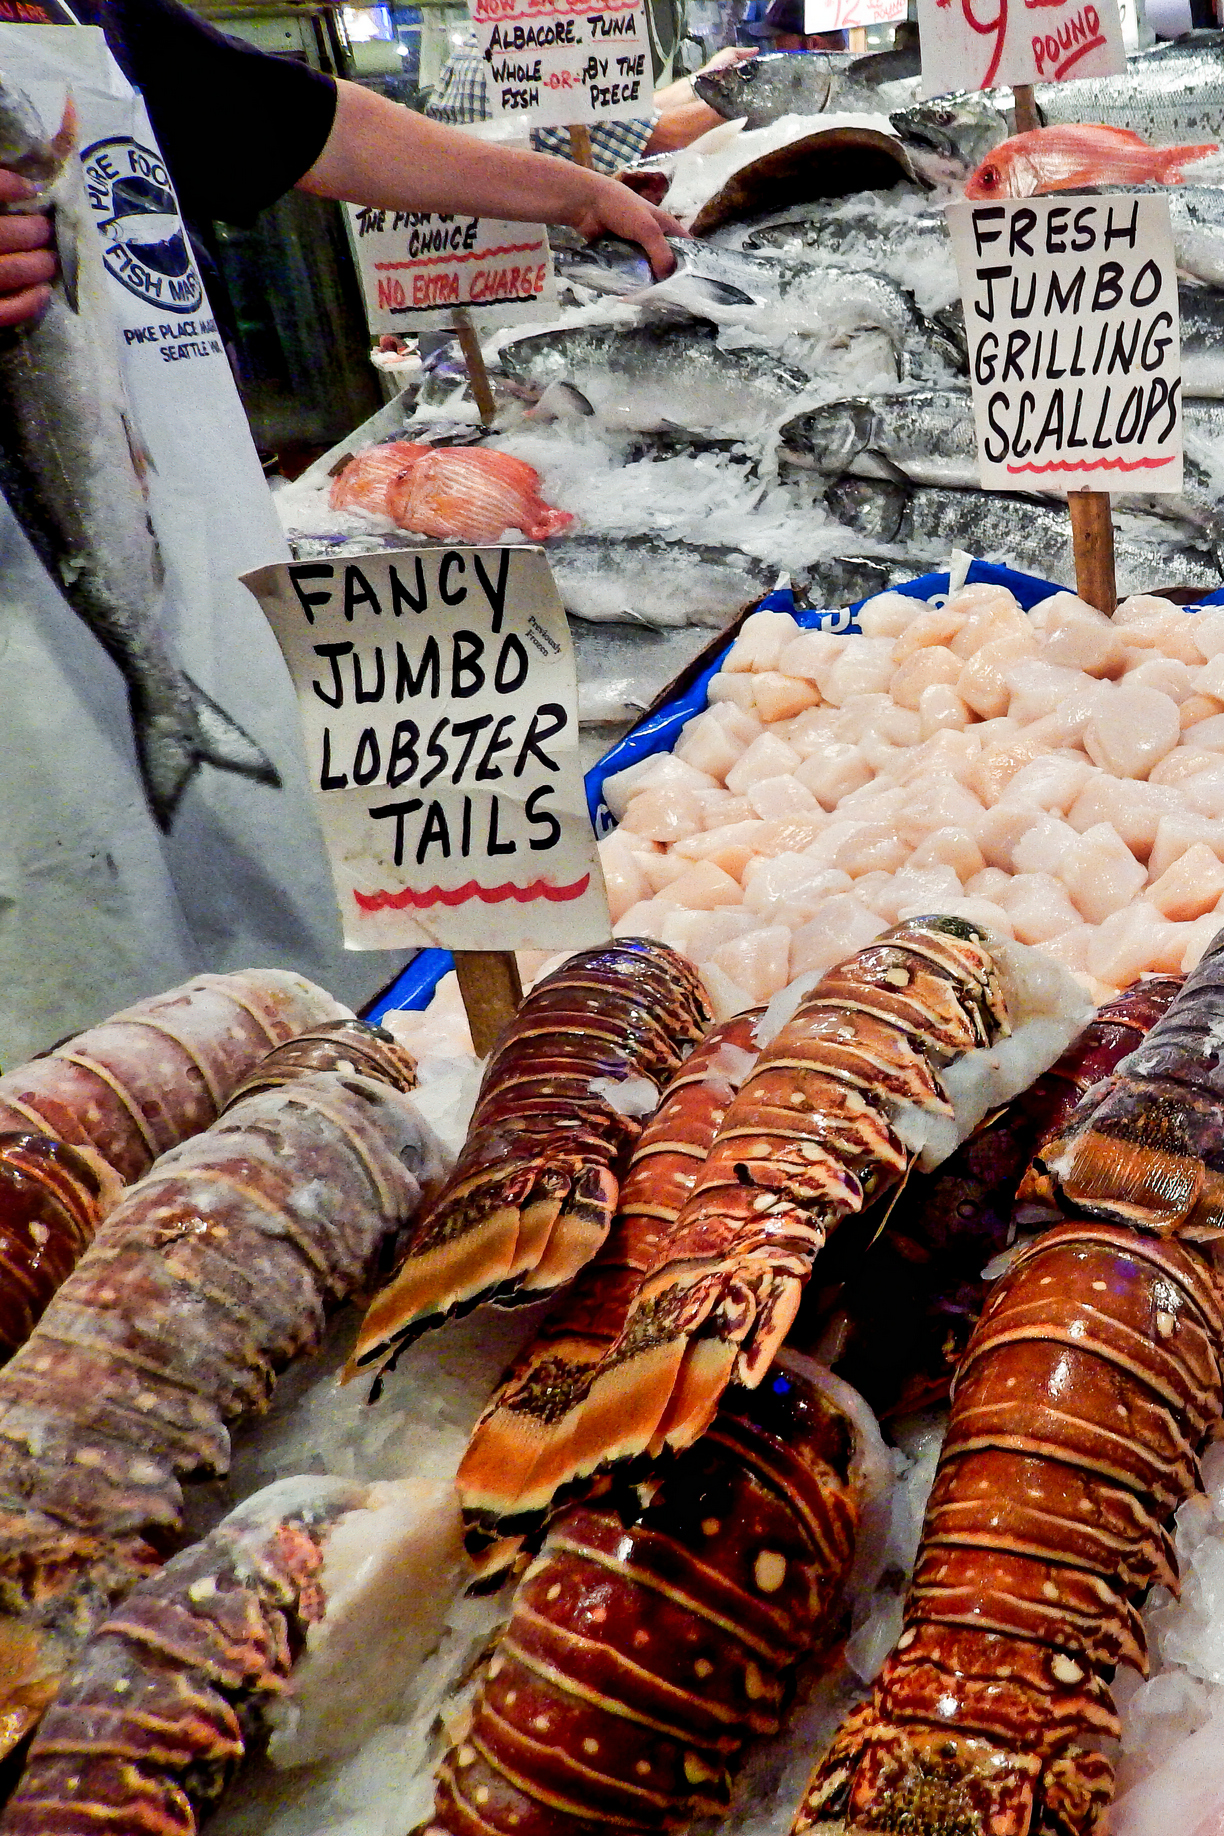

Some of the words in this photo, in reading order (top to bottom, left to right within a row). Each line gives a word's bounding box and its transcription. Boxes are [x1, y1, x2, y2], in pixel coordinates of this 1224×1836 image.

[587, 13, 637, 38] TUNA
[1032, 5, 1101, 76] POUND
[492, 59, 542, 83] WHOLE
[587, 56, 609, 81] BY
[616, 54, 646, 77] THE
[502, 87, 540, 110] FISH
[590, 80, 641, 110] PIECE
[87, 154, 119, 212] PURE
[128, 150, 171, 188] FOO
[355, 207, 386, 238] THE
[409, 222, 478, 258] CHOICE
[972, 200, 1139, 257] FRESH
[106, 243, 162, 298] FISH
[168, 271, 200, 302] MAR
[377, 276, 405, 309] NO
[413, 273, 459, 306] EXTRA
[470, 263, 546, 301] CHARGE
[974, 259, 1162, 323] JUMBO
[123, 325, 160, 346] PIKE
[159, 320, 198, 340] PLACE
[160, 341, 210, 363] SEATTLE
[975, 311, 1173, 385] GRILLING
[984, 376, 1181, 463] SCALLOPS
[288, 548, 510, 633] FANCY
[528, 615, 561, 655] Previously
[312, 629, 529, 709] JUMBO
[320, 703, 568, 791] LOBSTER
[368, 784, 562, 866] TAILS
